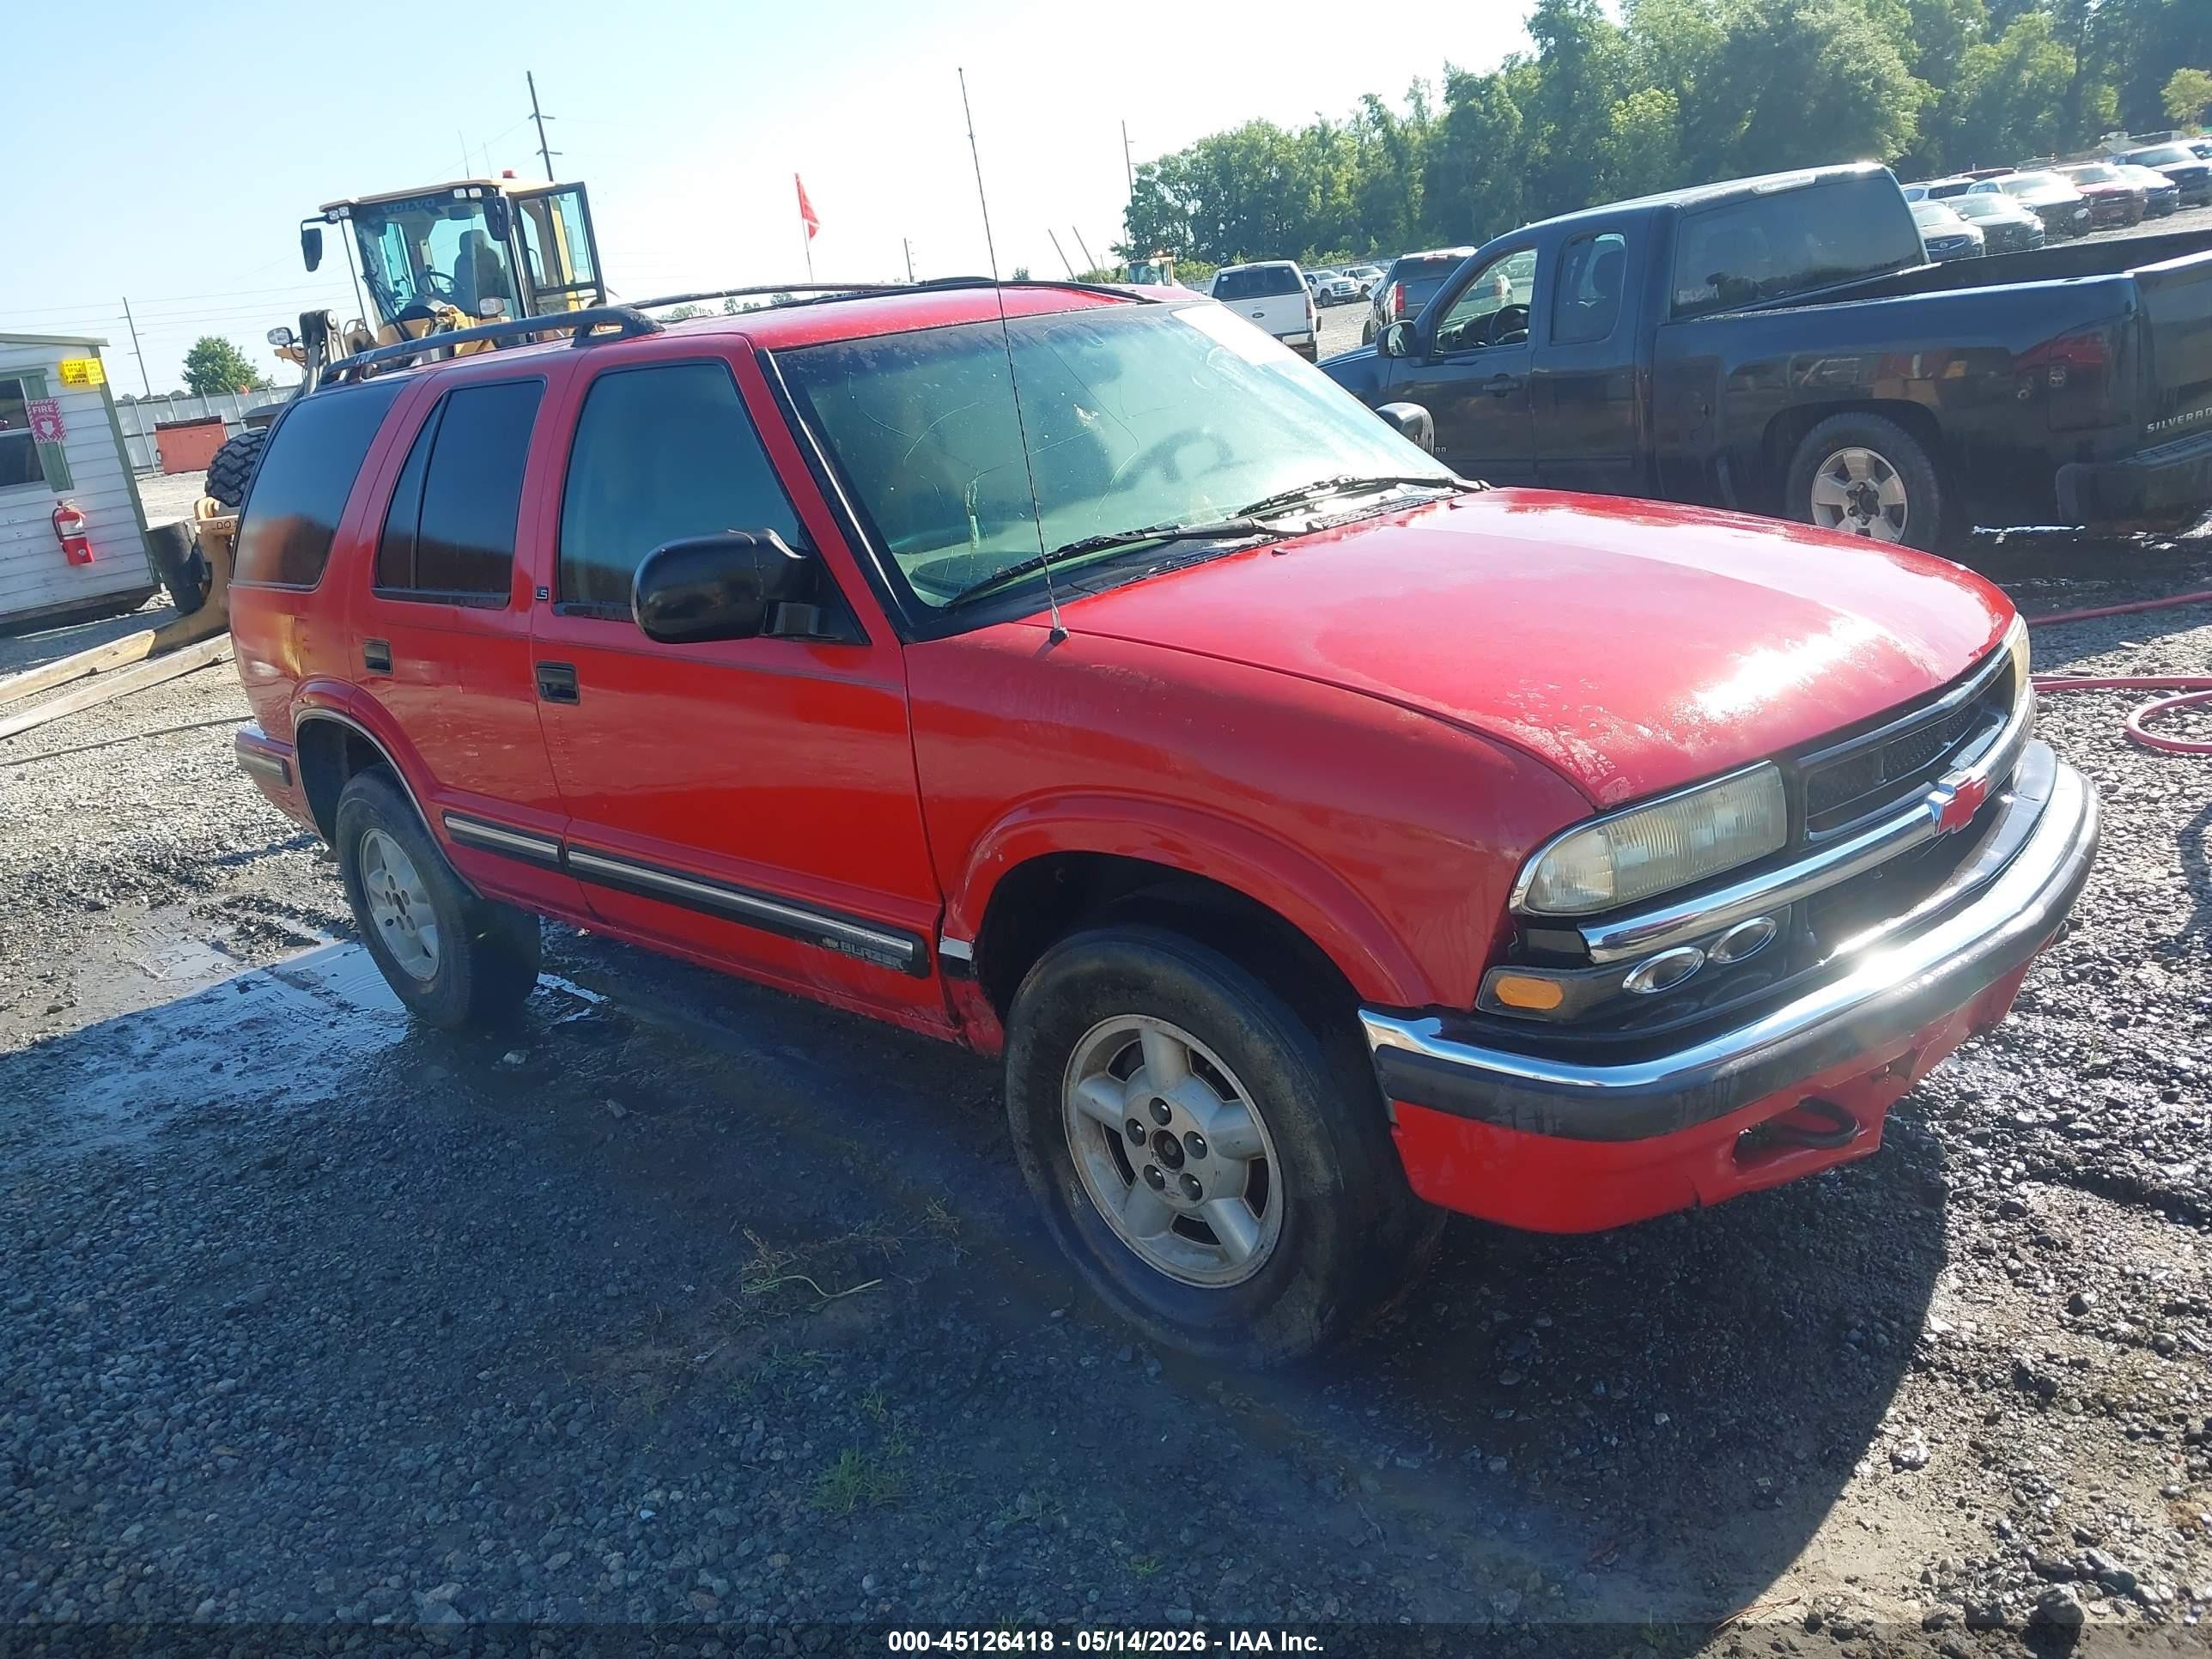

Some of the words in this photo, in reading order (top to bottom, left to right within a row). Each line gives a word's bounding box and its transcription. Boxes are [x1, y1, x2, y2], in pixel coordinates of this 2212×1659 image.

[382, 198, 434, 213] VOLVO
[33, 404, 55, 414] FIRE
[216, 520, 232, 529] DO
